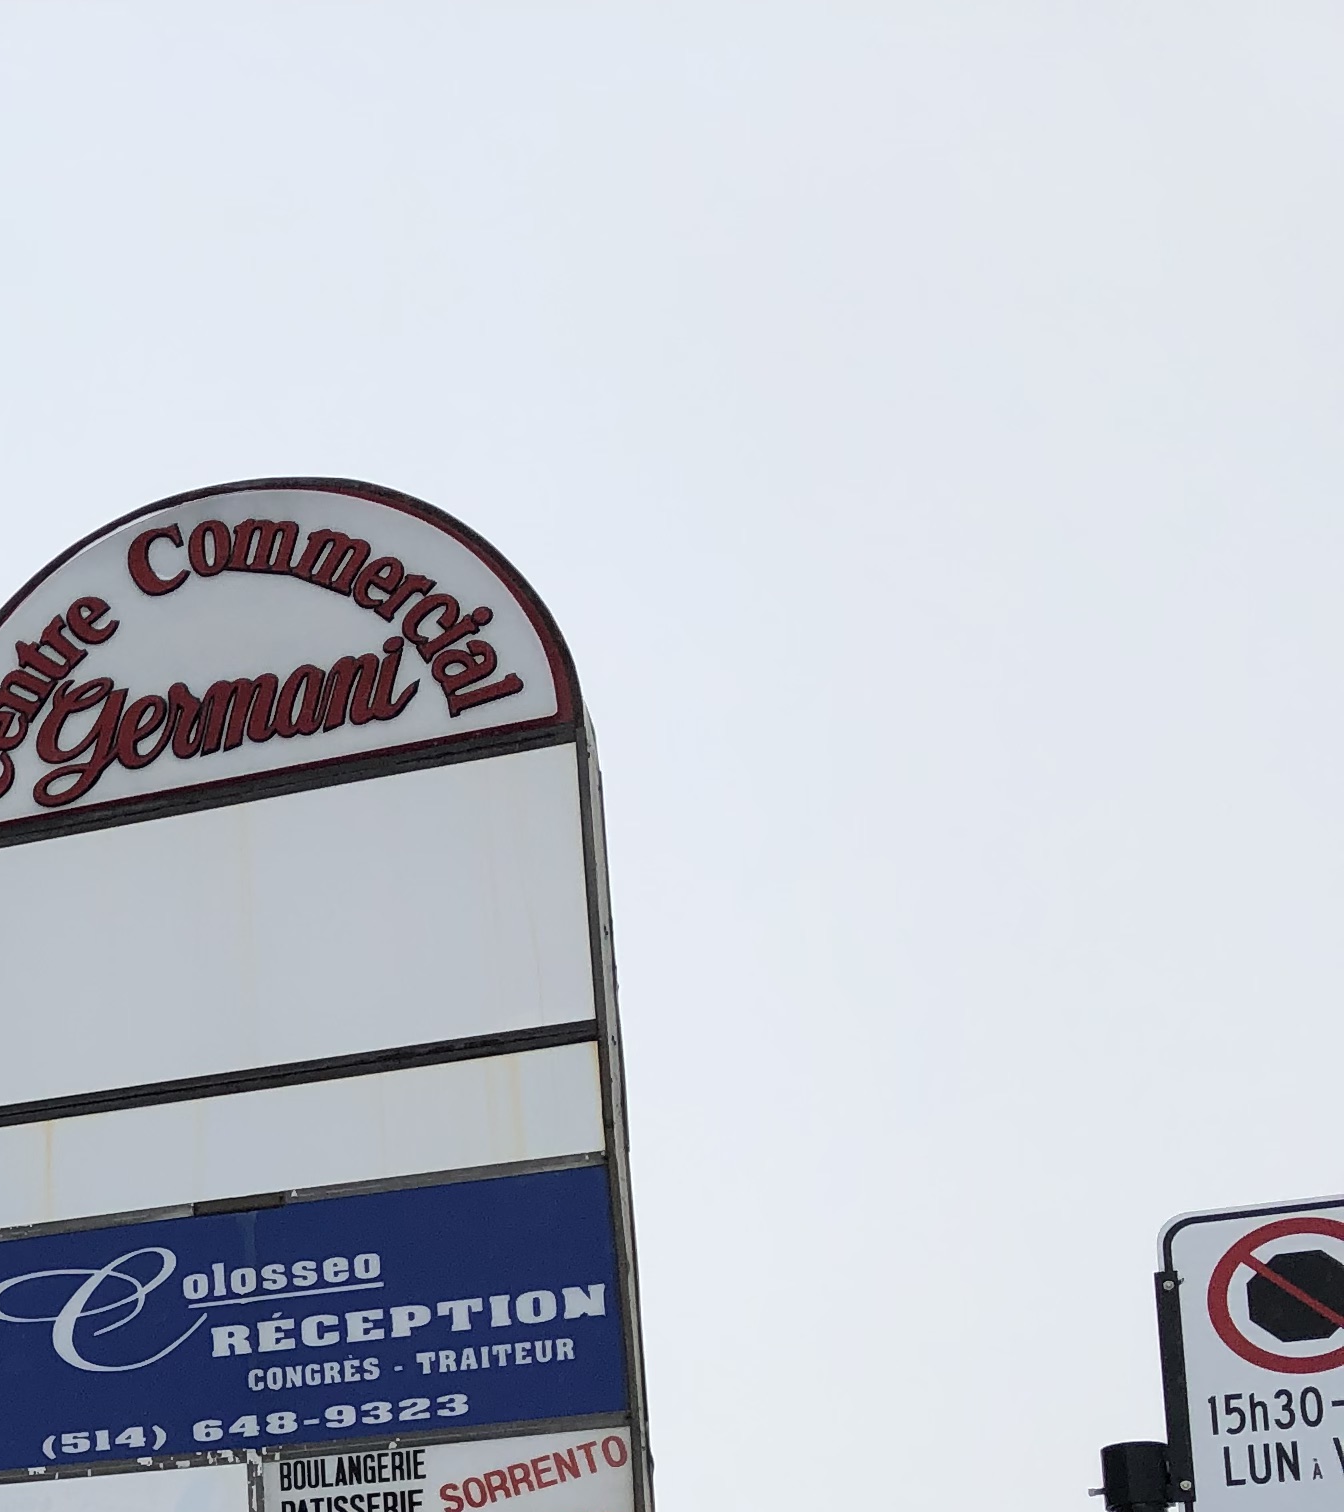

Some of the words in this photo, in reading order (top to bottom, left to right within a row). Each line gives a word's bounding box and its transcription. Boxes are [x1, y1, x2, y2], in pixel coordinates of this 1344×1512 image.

[127, 517, 524, 717] Commercial
[32, 636, 421, 809] Germani
[212, 1282, 607, 1358] RÉCEPTION
[247, 1356, 381, 1393] CONGRÈS
[416, 1337, 576, 1375] TRAITEUR
[41, 1425, 168, 1461] (514)
[192, 1393, 471, 1444] 648-9323
[279, 1449, 427, 1492] BOULANGERIE
[1223, 1440, 1301, 1487] LUN
